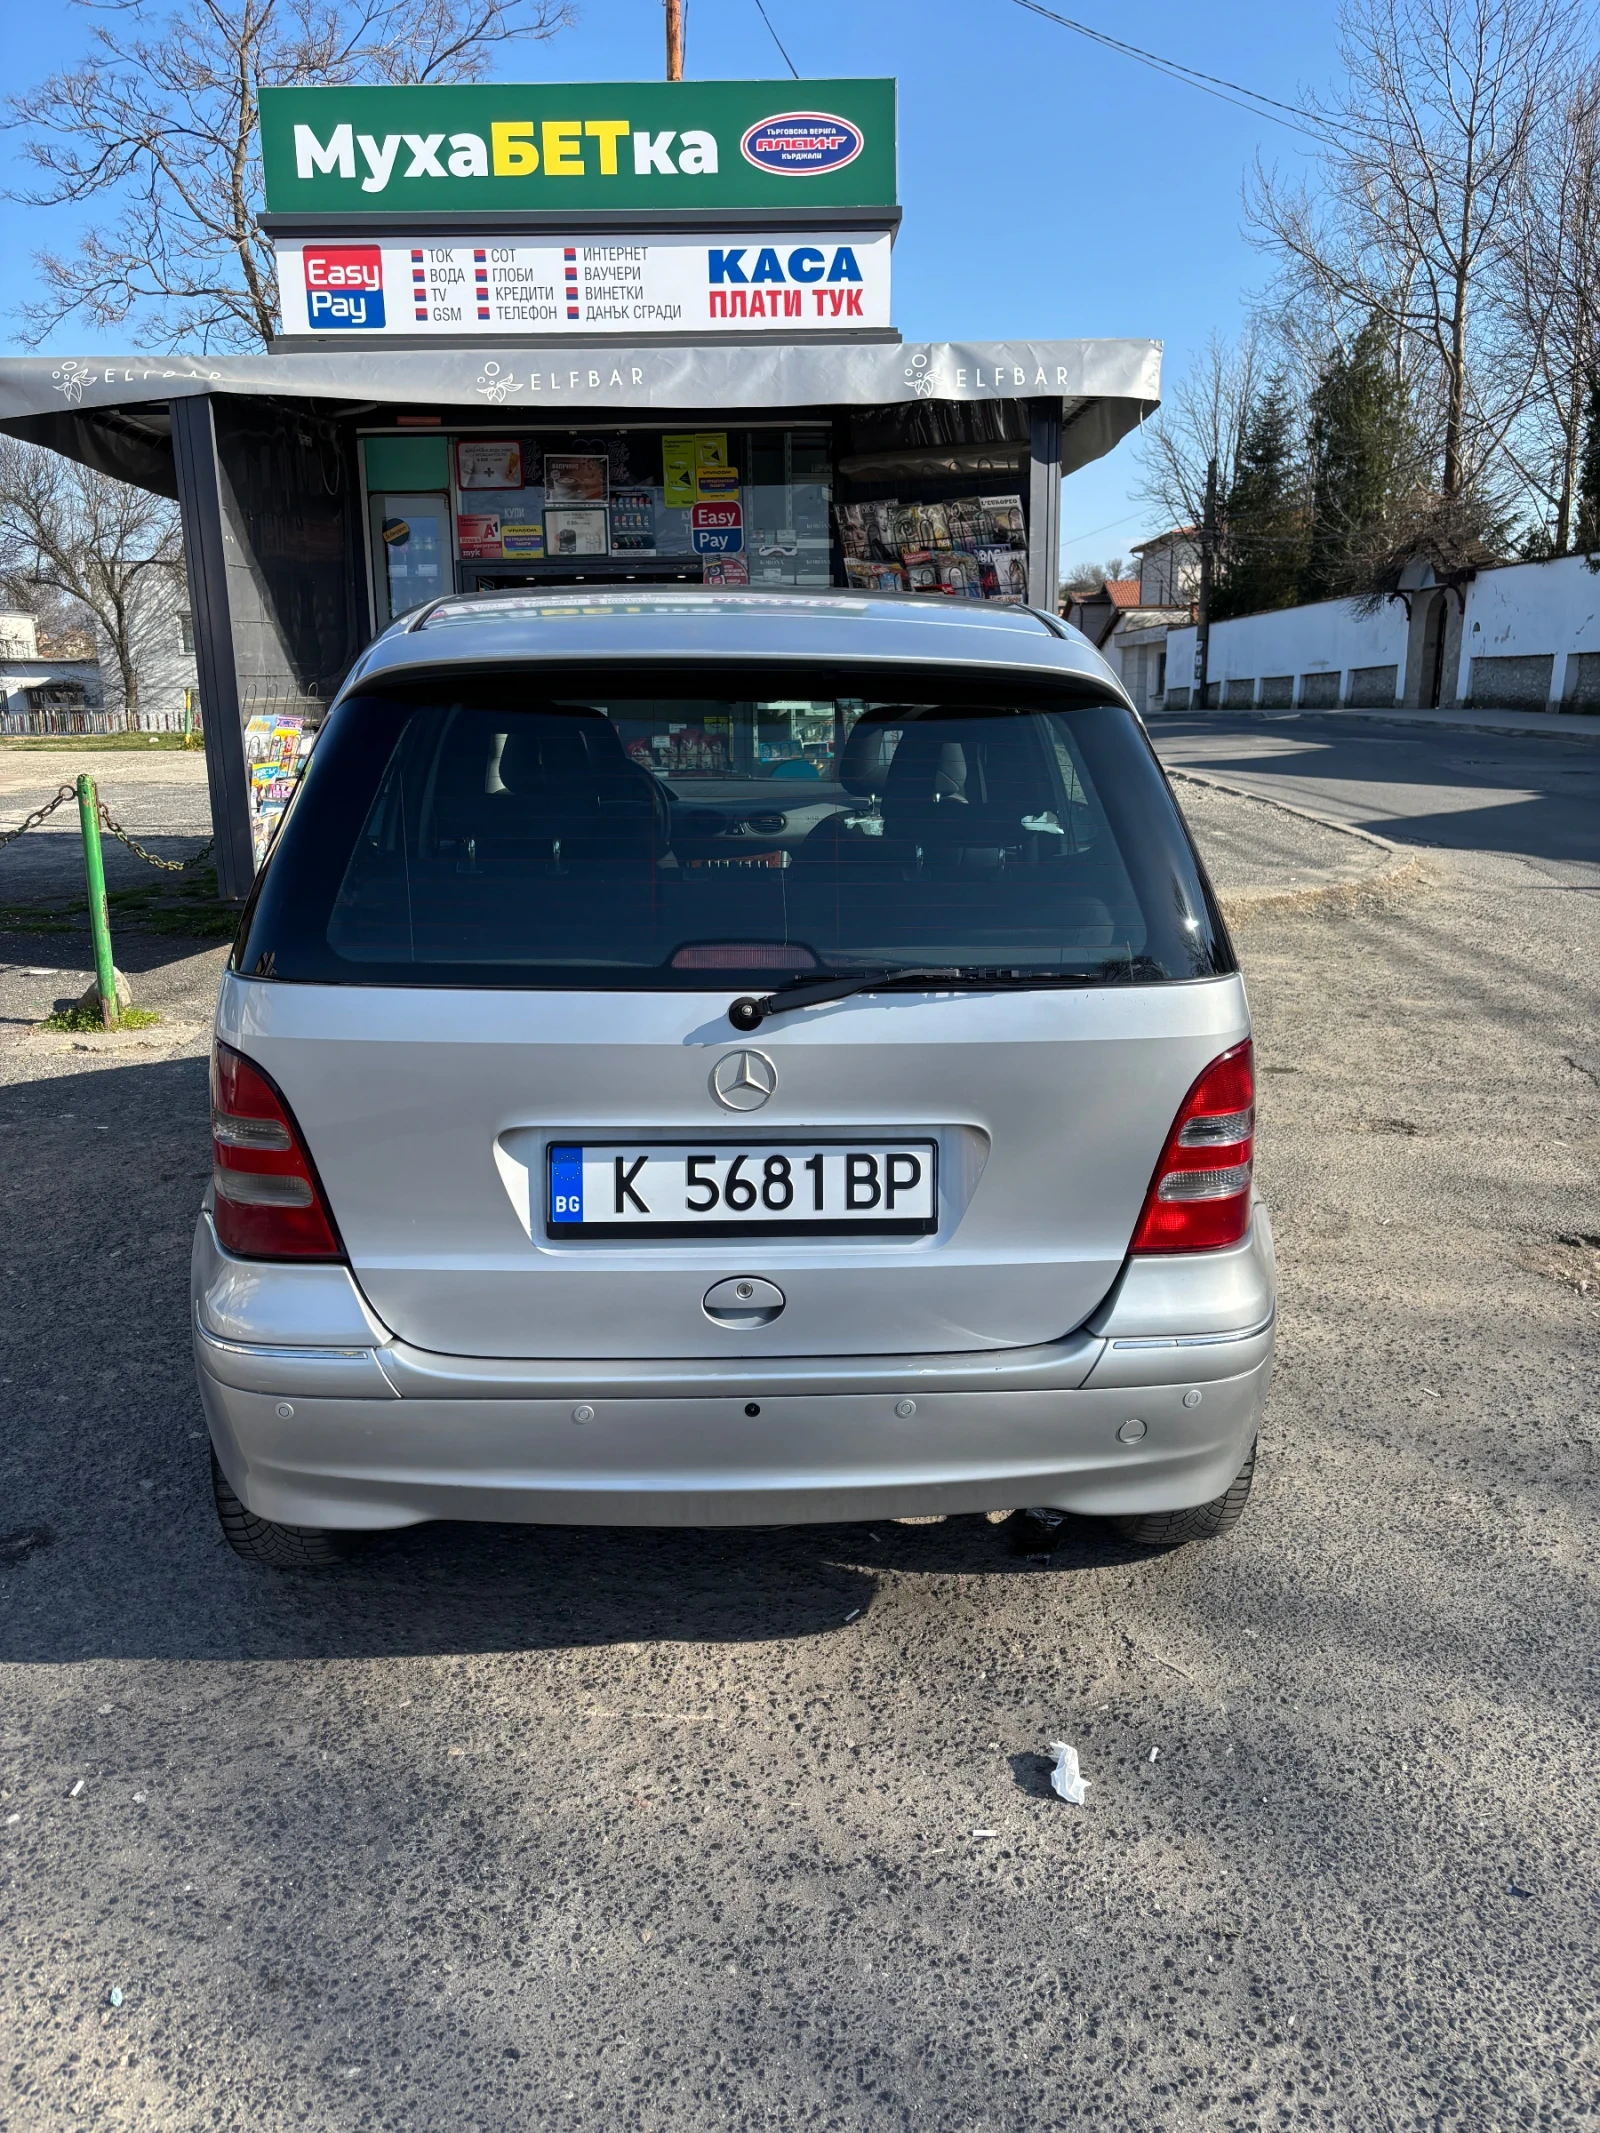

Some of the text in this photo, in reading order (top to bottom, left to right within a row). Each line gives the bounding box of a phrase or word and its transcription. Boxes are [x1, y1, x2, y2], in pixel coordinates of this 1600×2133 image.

[766, 127, 837, 136] ТЪРГОВСКА ВЕРИГА
[293, 120, 718, 194] МухаБЕТка
[781, 152, 822, 161] КЪРДЖАЛИ
[428, 249, 454, 264] ТОК
[491, 249, 516, 263] СОТ
[583, 246, 649, 261] ИНТЕРНЕТ
[584, 266, 641, 281] ВАУЧЕРИ
[708, 246, 864, 284] КАСА
[306, 258, 380, 292] Easy
[430, 268, 466, 285] ВОДА
[492, 267, 534, 283] ГЛОБИ
[431, 288, 447, 302] TV
[495, 286, 555, 303] КРЕДИТИ
[585, 285, 644, 301] ВИНЕТКИ
[311, 291, 367, 323] Pay
[496, 305, 558, 320] ТЕЛЕФОН
[708, 289, 865, 319] ПЛАТИ ТУК
[433, 307, 462, 321] GSM
[586, 304, 682, 322] ДАНЪК СГРАДИ
[531, 366, 644, 391] ELFBAR
[956, 366, 1070, 388] ELFBAR
[504, 507, 525, 518] КУПИ
[697, 509, 737, 526] Easy
[483, 521, 498, 539] A1
[699, 532, 729, 550] Pay
[613, 1155, 651, 1214] K
[554, 1194, 581, 1214] BG
